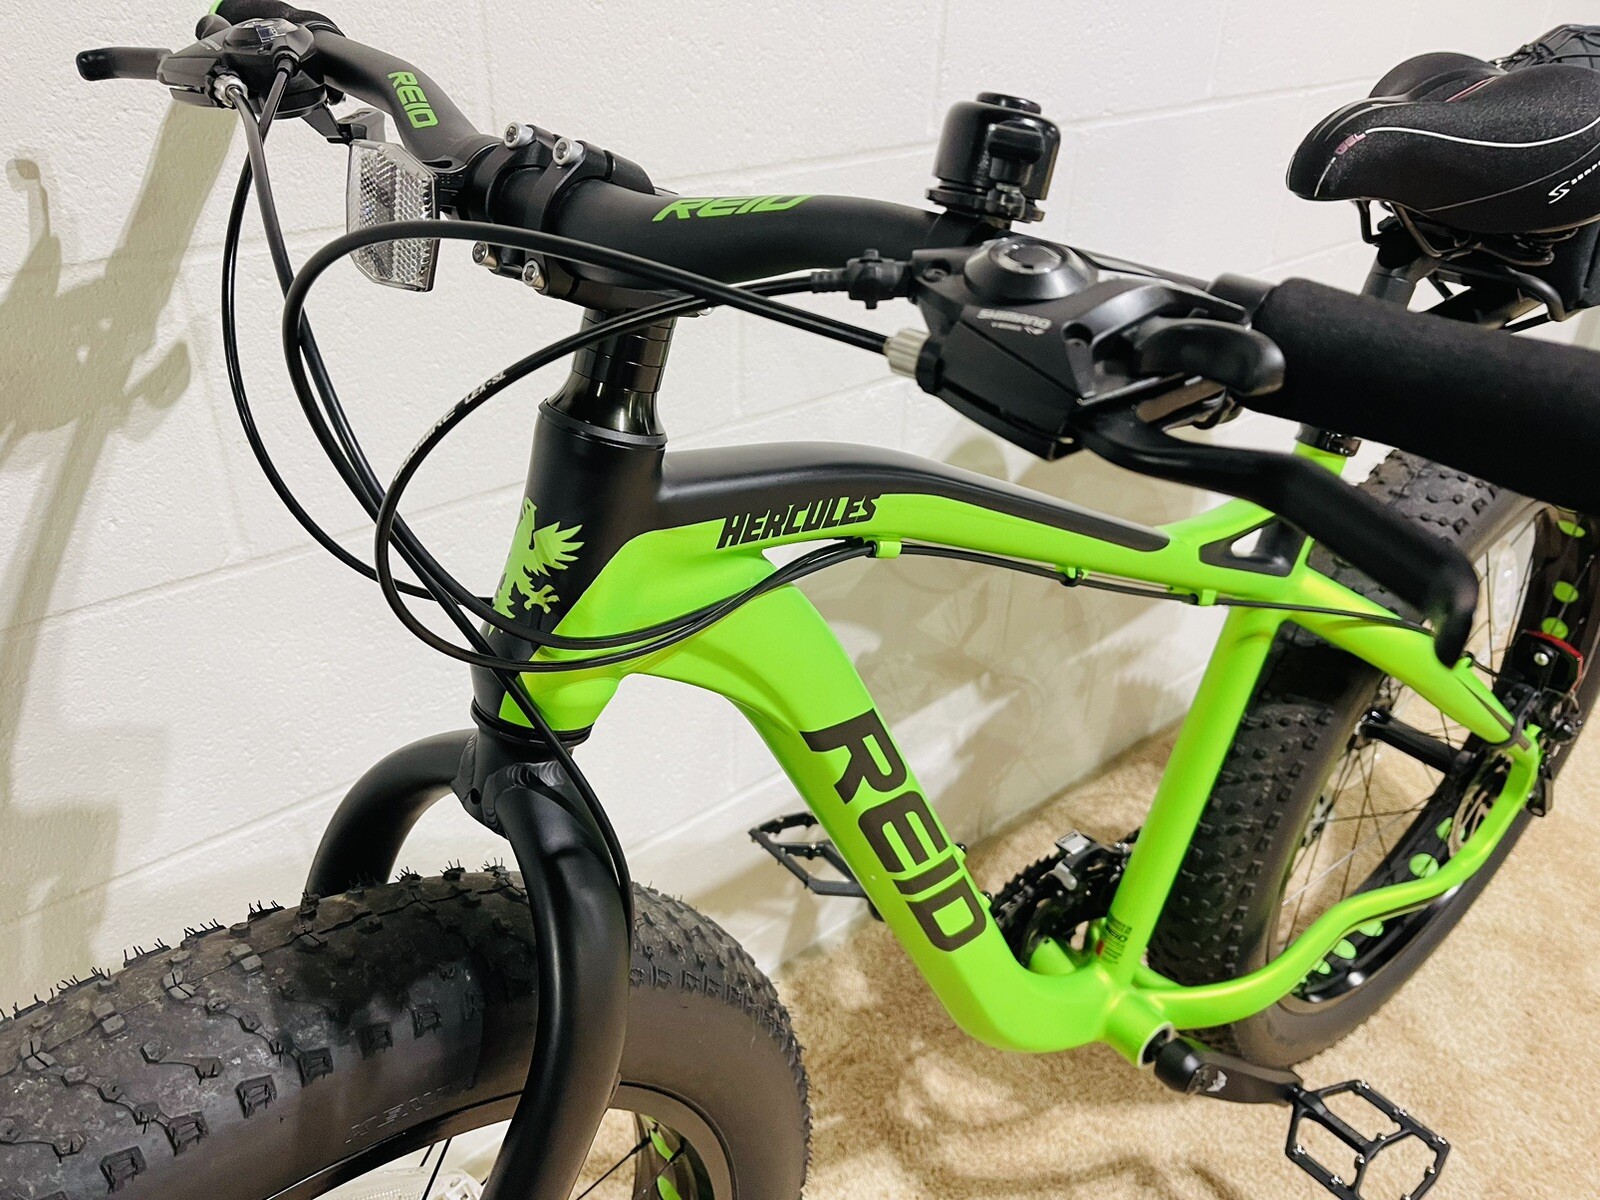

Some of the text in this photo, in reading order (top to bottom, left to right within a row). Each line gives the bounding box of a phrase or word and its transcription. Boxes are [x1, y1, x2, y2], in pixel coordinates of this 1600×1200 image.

[387, 71, 439, 128] REID
[651, 195, 813, 222] REID
[715, 494, 878, 549] HERCULES
[799, 708, 987, 952] REID
